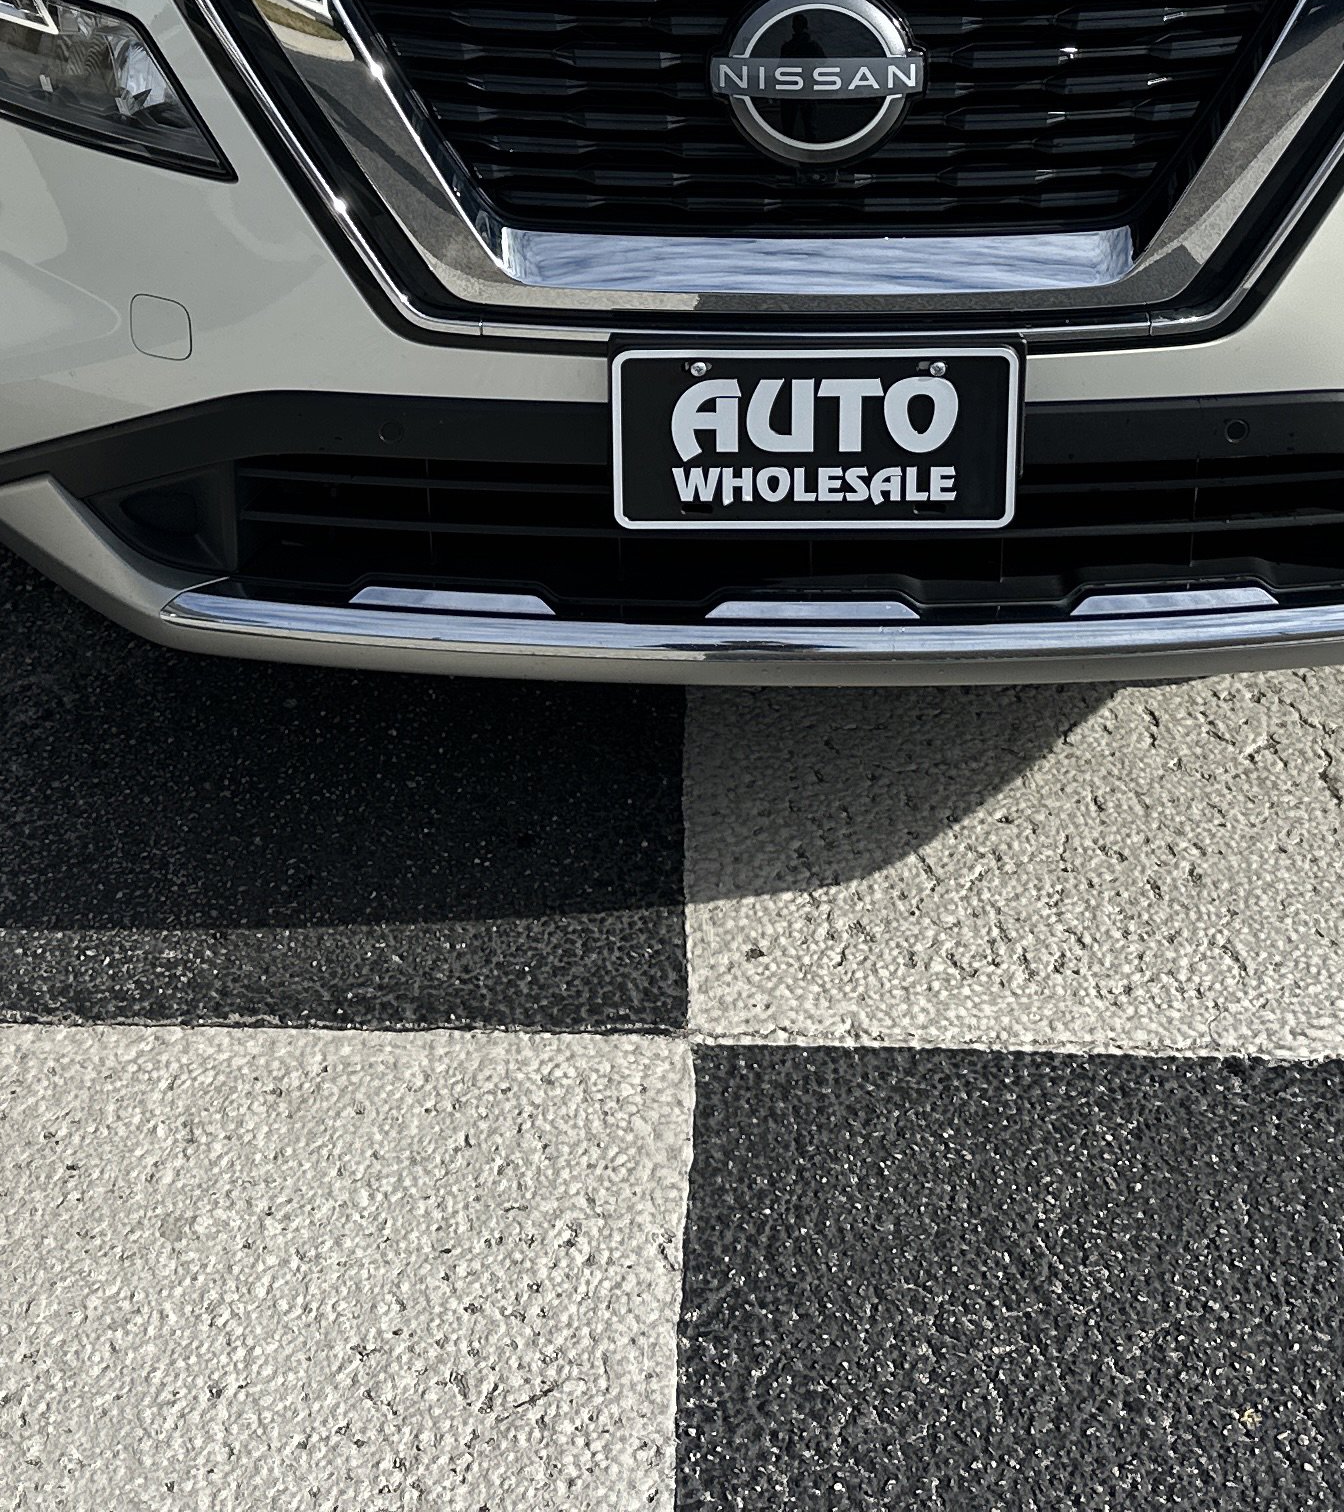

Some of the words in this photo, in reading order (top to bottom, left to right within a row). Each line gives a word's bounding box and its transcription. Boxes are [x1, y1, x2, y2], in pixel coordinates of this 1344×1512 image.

[718, 62, 918, 92] NISSAN
[670, 375, 959, 463] AUTO
[671, 465, 957, 507] WHOLESALE
